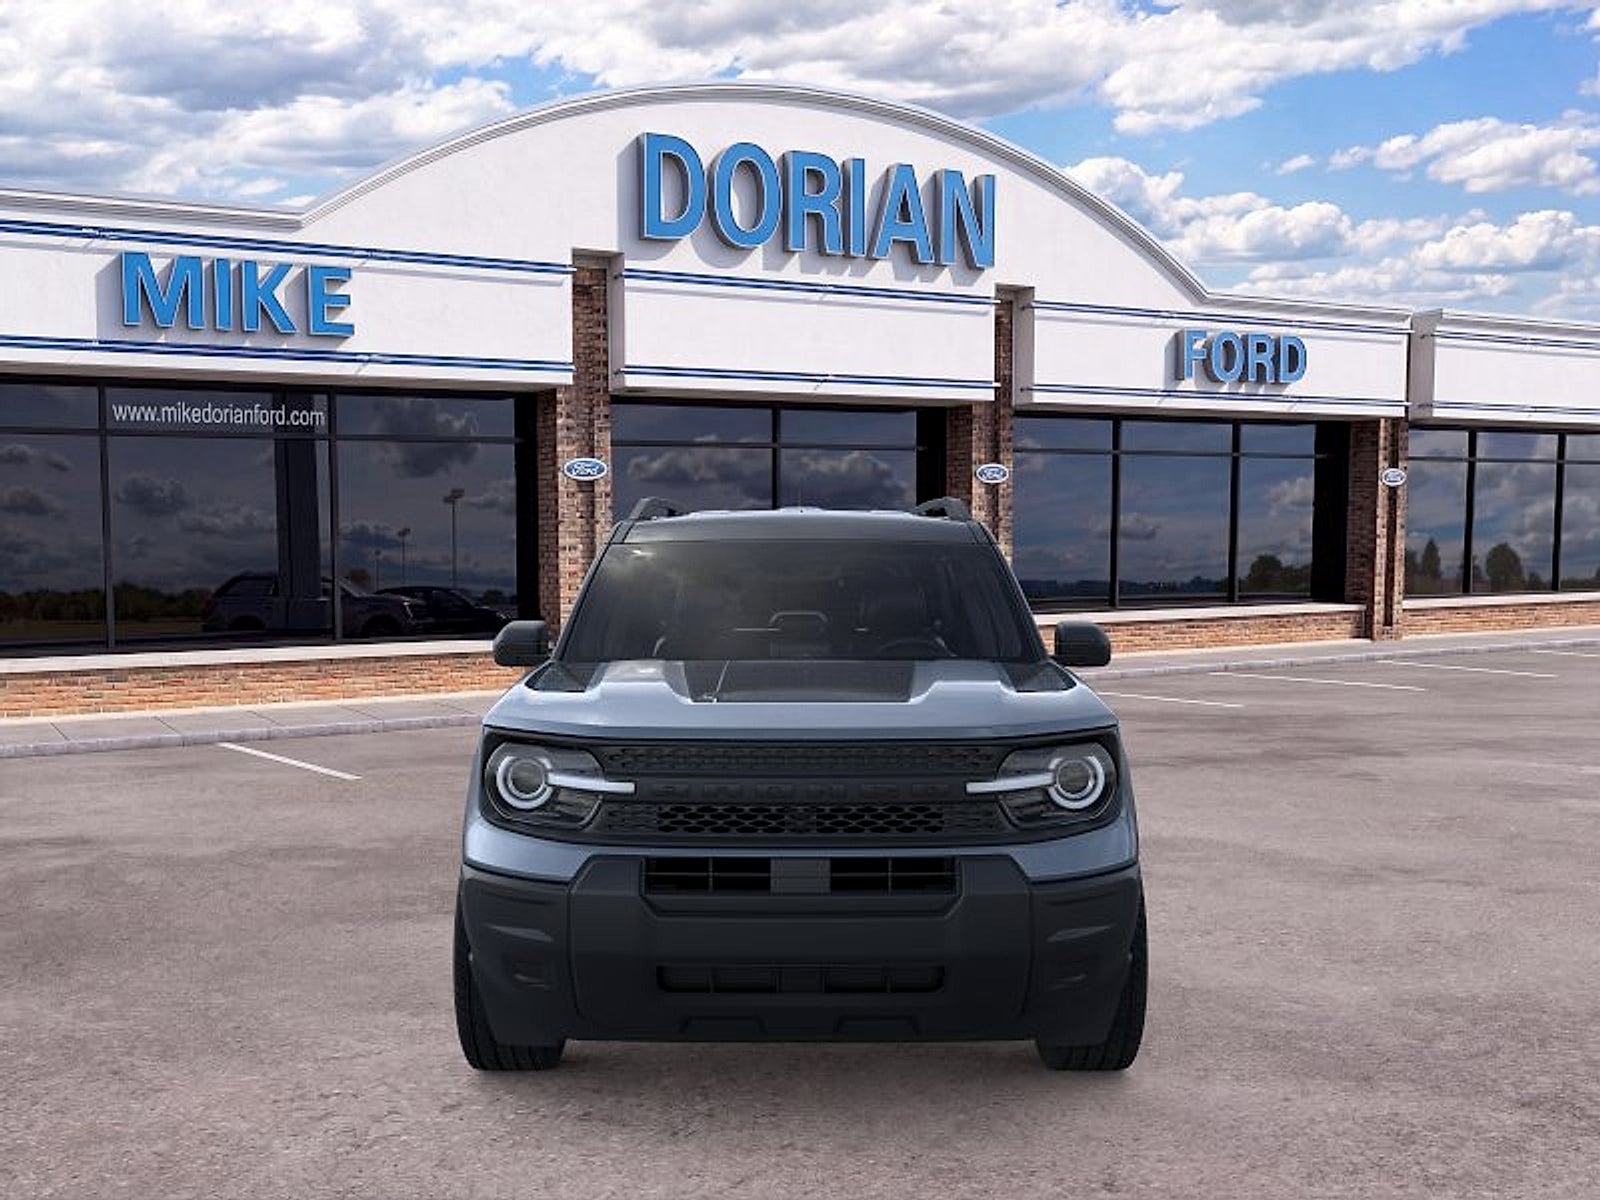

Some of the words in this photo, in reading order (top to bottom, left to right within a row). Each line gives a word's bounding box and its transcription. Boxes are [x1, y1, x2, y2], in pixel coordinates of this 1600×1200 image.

[640, 132, 996, 269] DORIAN
[120, 251, 355, 337] MIKE
[1178, 328, 1308, 384] FORD
[112, 401, 326, 427] www.mikedorianford.com
